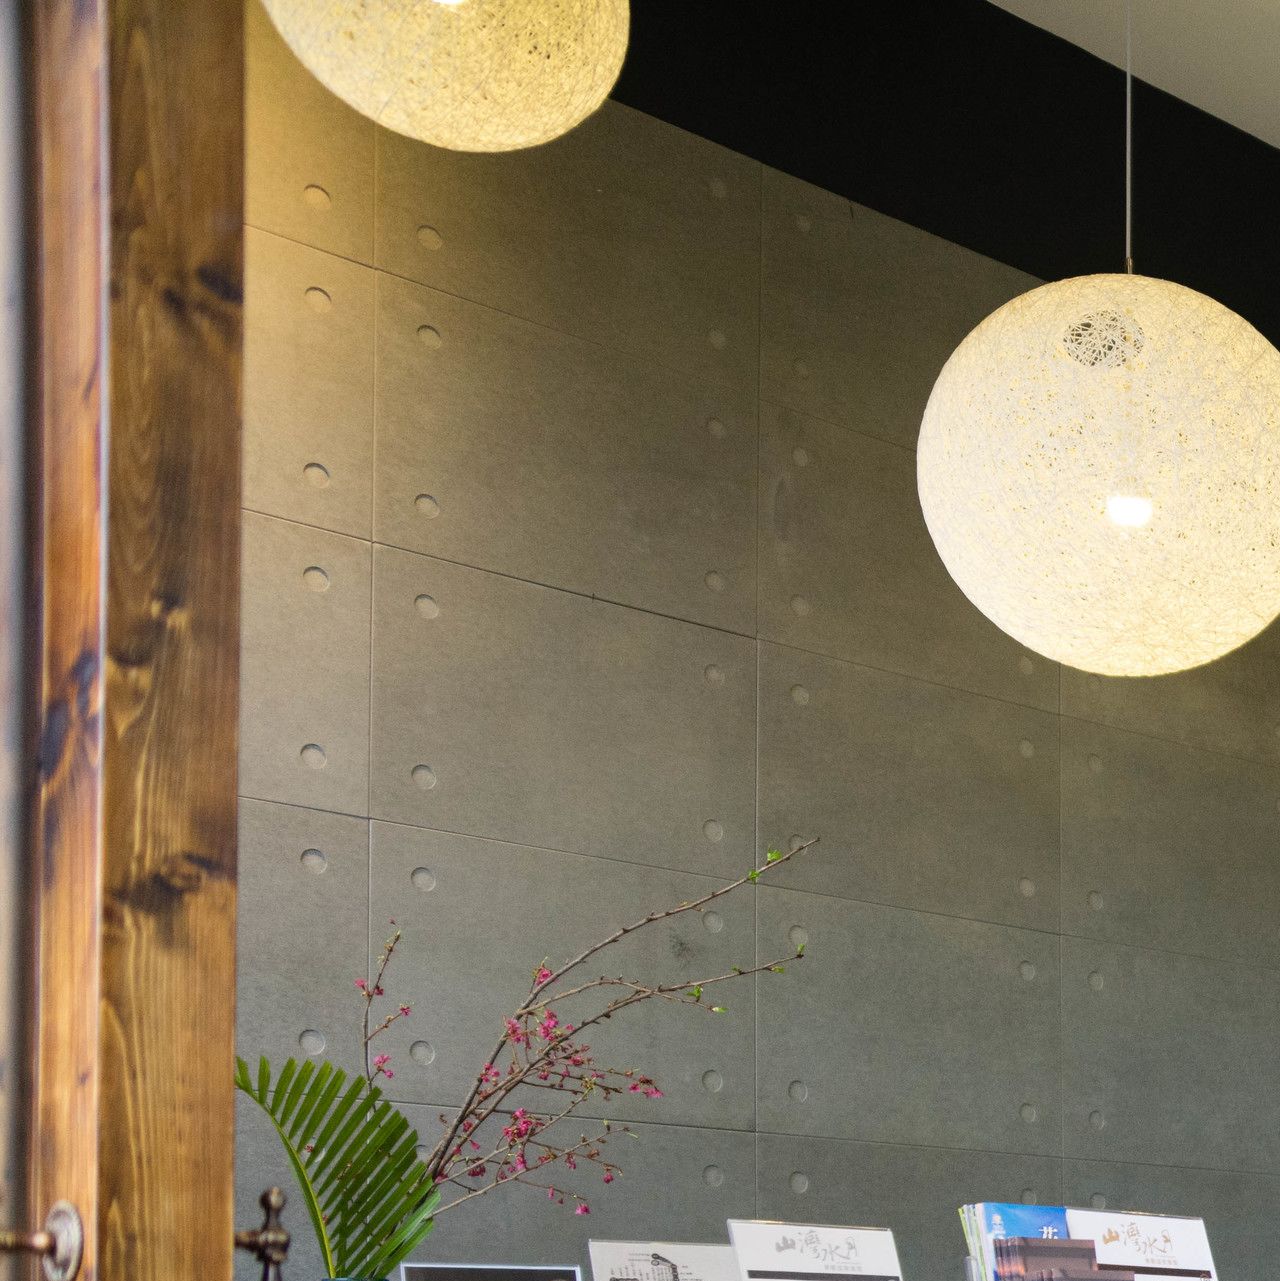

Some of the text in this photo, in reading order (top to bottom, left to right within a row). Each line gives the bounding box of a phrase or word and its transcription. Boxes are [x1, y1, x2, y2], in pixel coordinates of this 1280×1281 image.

[775, 1229, 858, 1262] 山灣水月
[1102, 1221, 1173, 1254] 山灣水月
